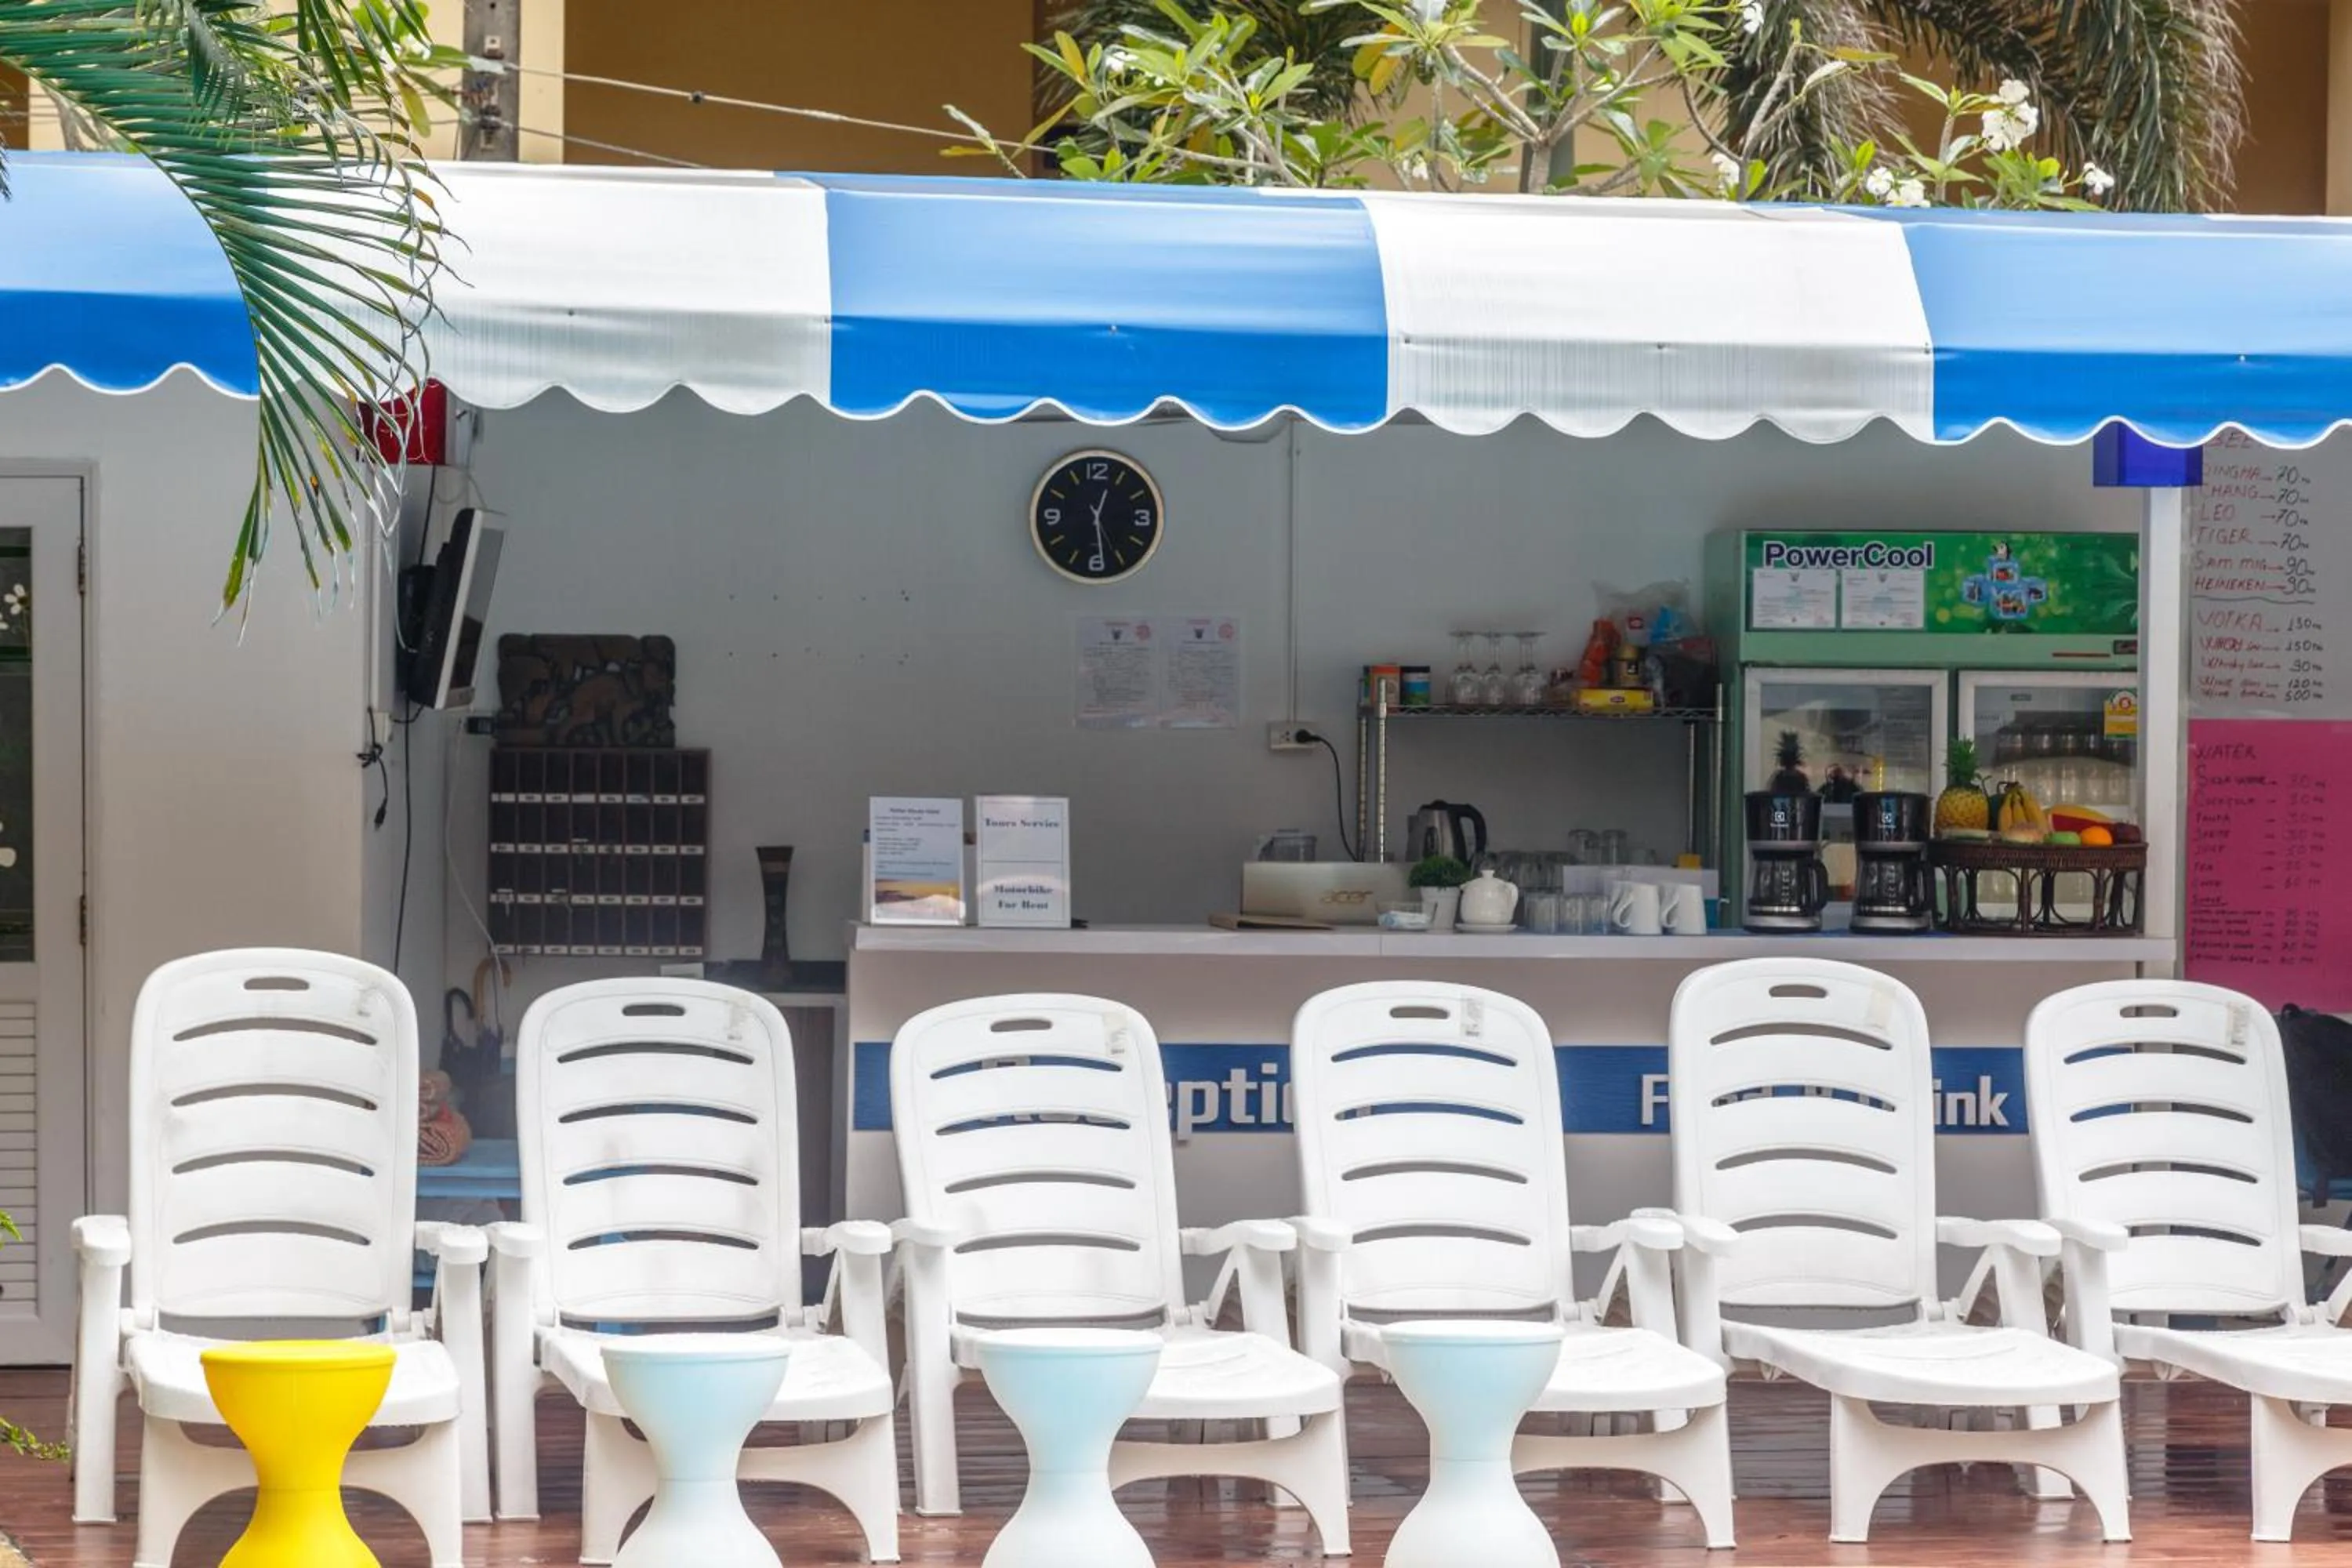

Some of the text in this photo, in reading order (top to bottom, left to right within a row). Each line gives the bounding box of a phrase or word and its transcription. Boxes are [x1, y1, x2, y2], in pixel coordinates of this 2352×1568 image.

[1087, 463, 1109, 480] 12
[2276, 488, 2299, 506] 70
[1044, 509, 1061, 525] 9
[1134, 510, 1150, 526] 3
[2200, 504, 2234, 521] LEO
[2275, 508, 2298, 527] 70
[2198, 526, 2300, 550] TIGER 70
[1764, 541, 1934, 568] PowerCool
[1089, 555, 1105, 571] 6
[2285, 690, 2310, 702] 500
[2194, 742, 2256, 759] WATER
[1020, 818, 1059, 828] Service
[998, 900, 1049, 909] For Rent
